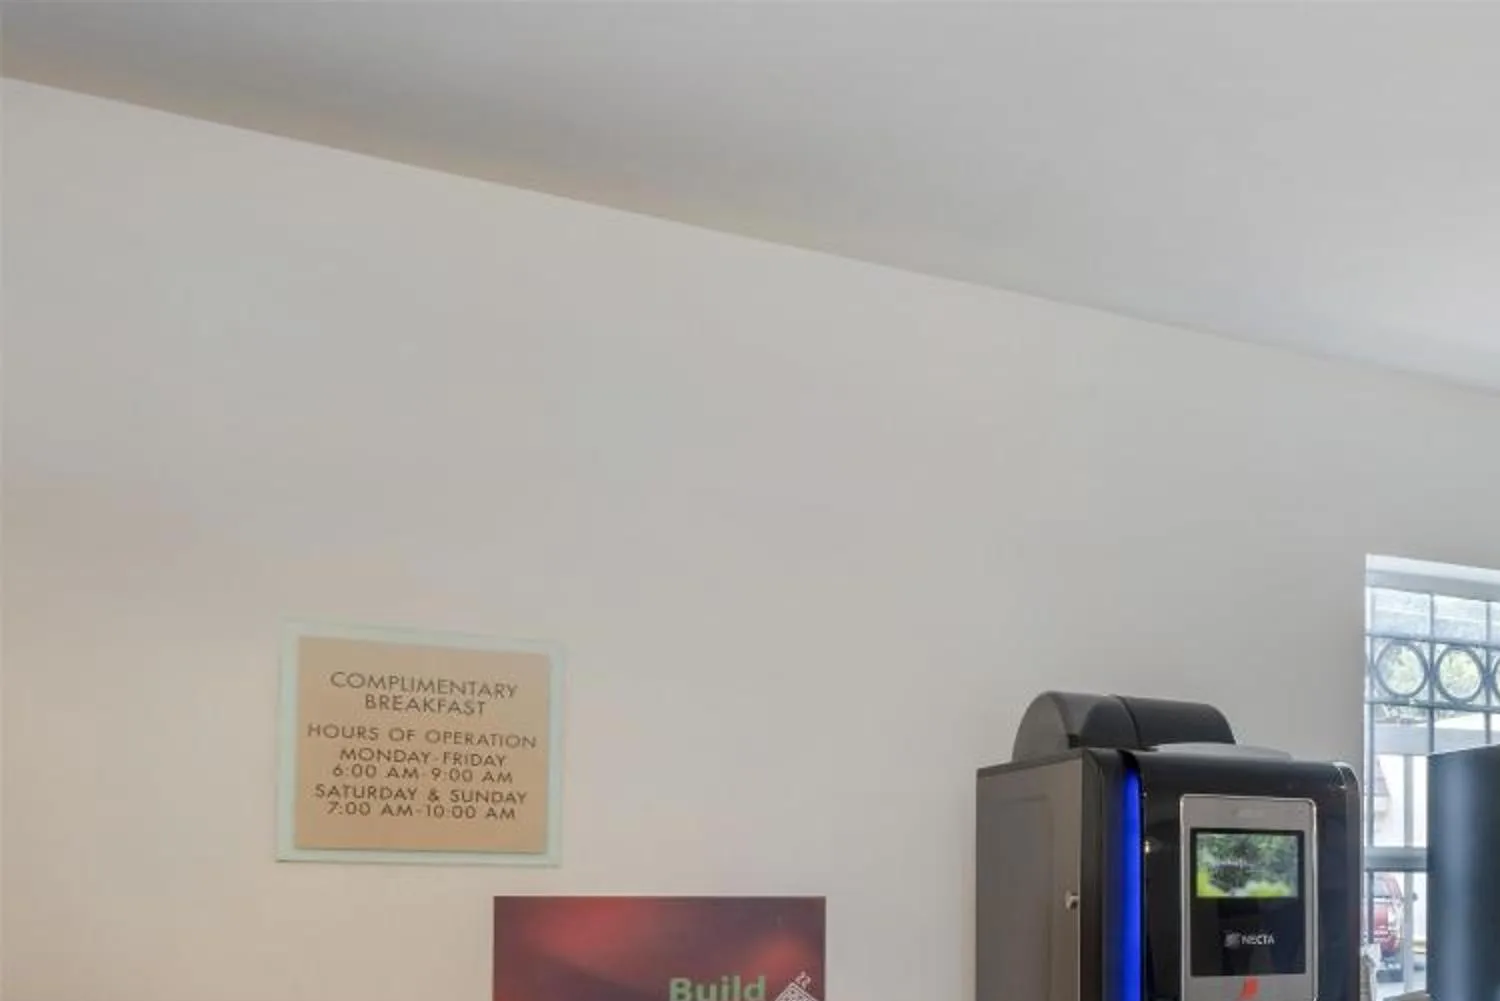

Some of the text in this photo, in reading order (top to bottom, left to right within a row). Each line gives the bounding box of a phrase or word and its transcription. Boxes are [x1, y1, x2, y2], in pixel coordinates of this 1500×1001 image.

[329, 671, 518, 699] COMPLIMENTARY
[364, 693, 487, 716] BREAKFAST
[307, 723, 537, 749] HOURS OF OPERATION
[332, 763, 377, 779] 6:00
[481, 771, 513, 784] AM
[314, 783, 528, 805] SATURDAY & SUNDAY
[326, 800, 372, 817] 7:00
[484, 807, 516, 820] AM
[1241, 933, 1275, 945] NECTA
